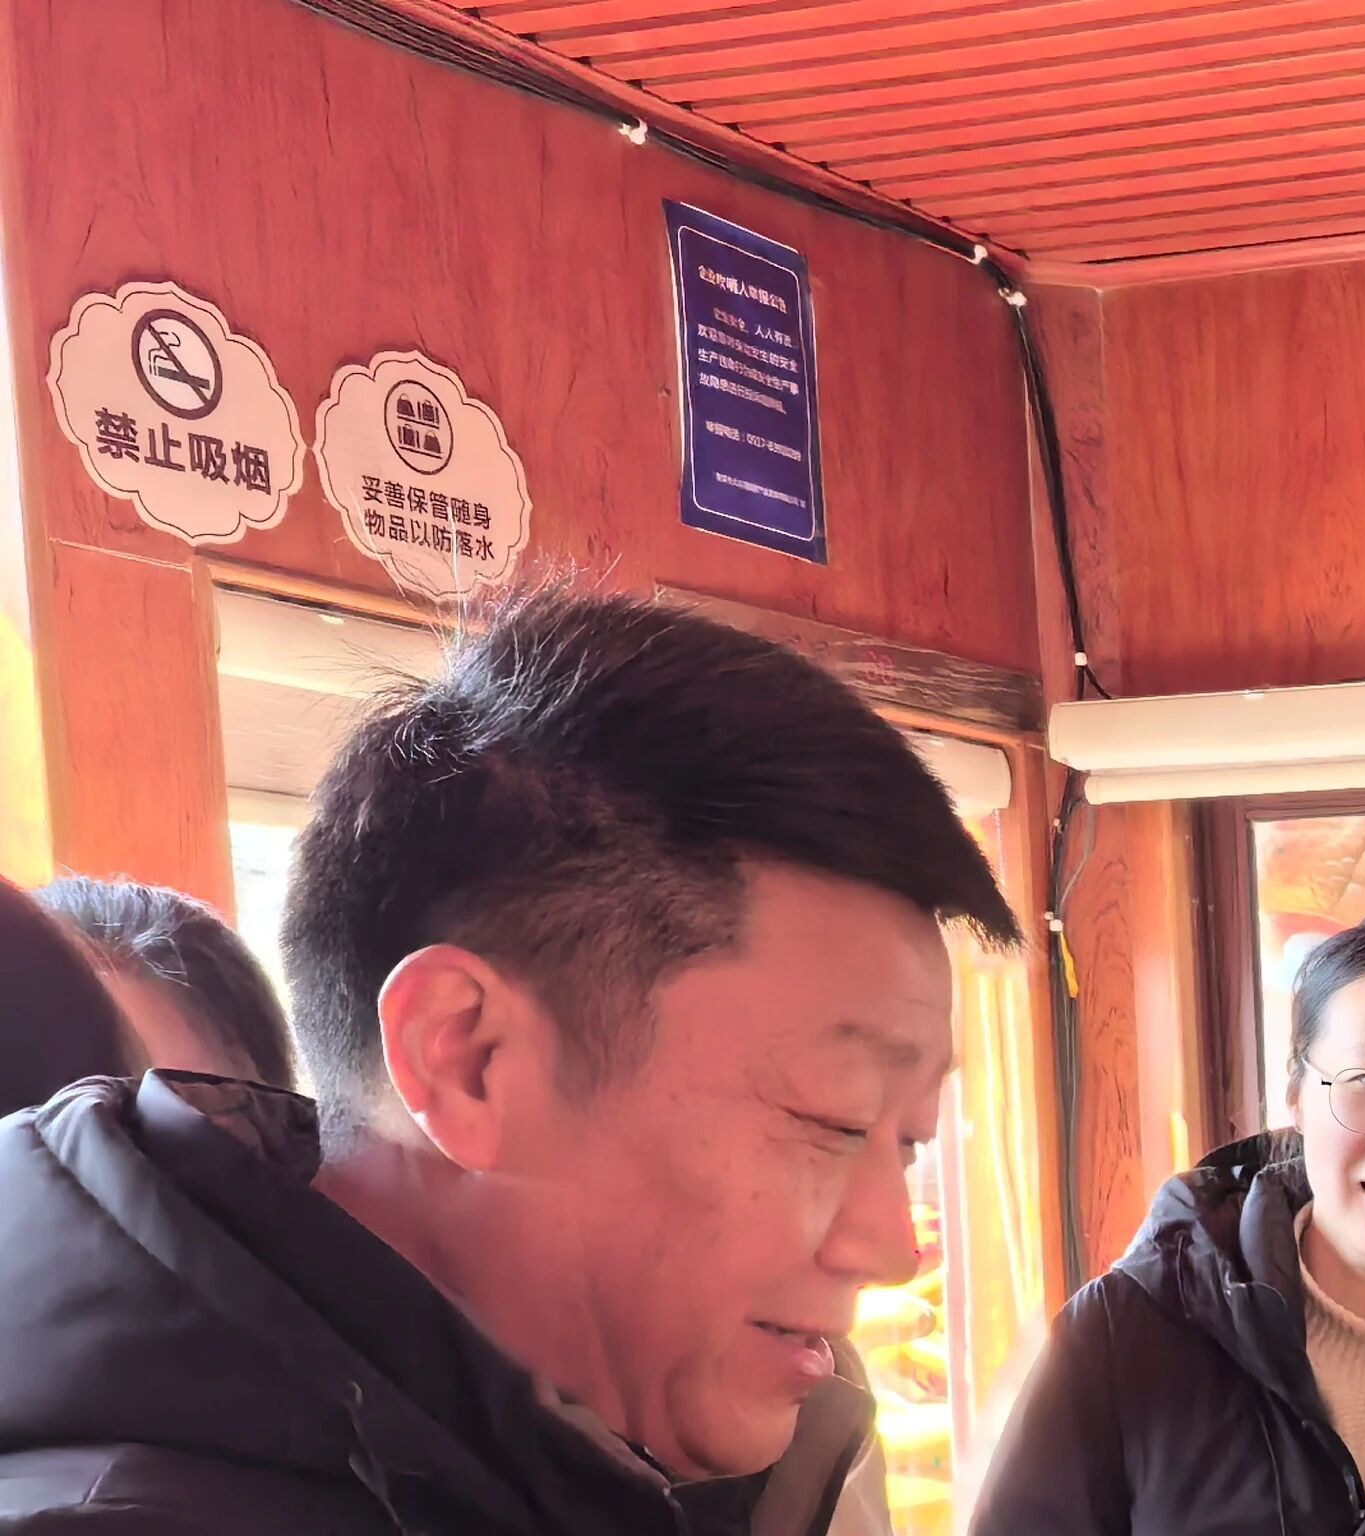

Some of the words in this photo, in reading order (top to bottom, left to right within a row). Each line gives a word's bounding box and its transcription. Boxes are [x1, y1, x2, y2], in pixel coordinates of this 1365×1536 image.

[94, 407, 271, 495] 禁止吸烟
[362, 475, 491, 529] 妥善保管随身
[364, 508, 494, 561] 物品以防落水
